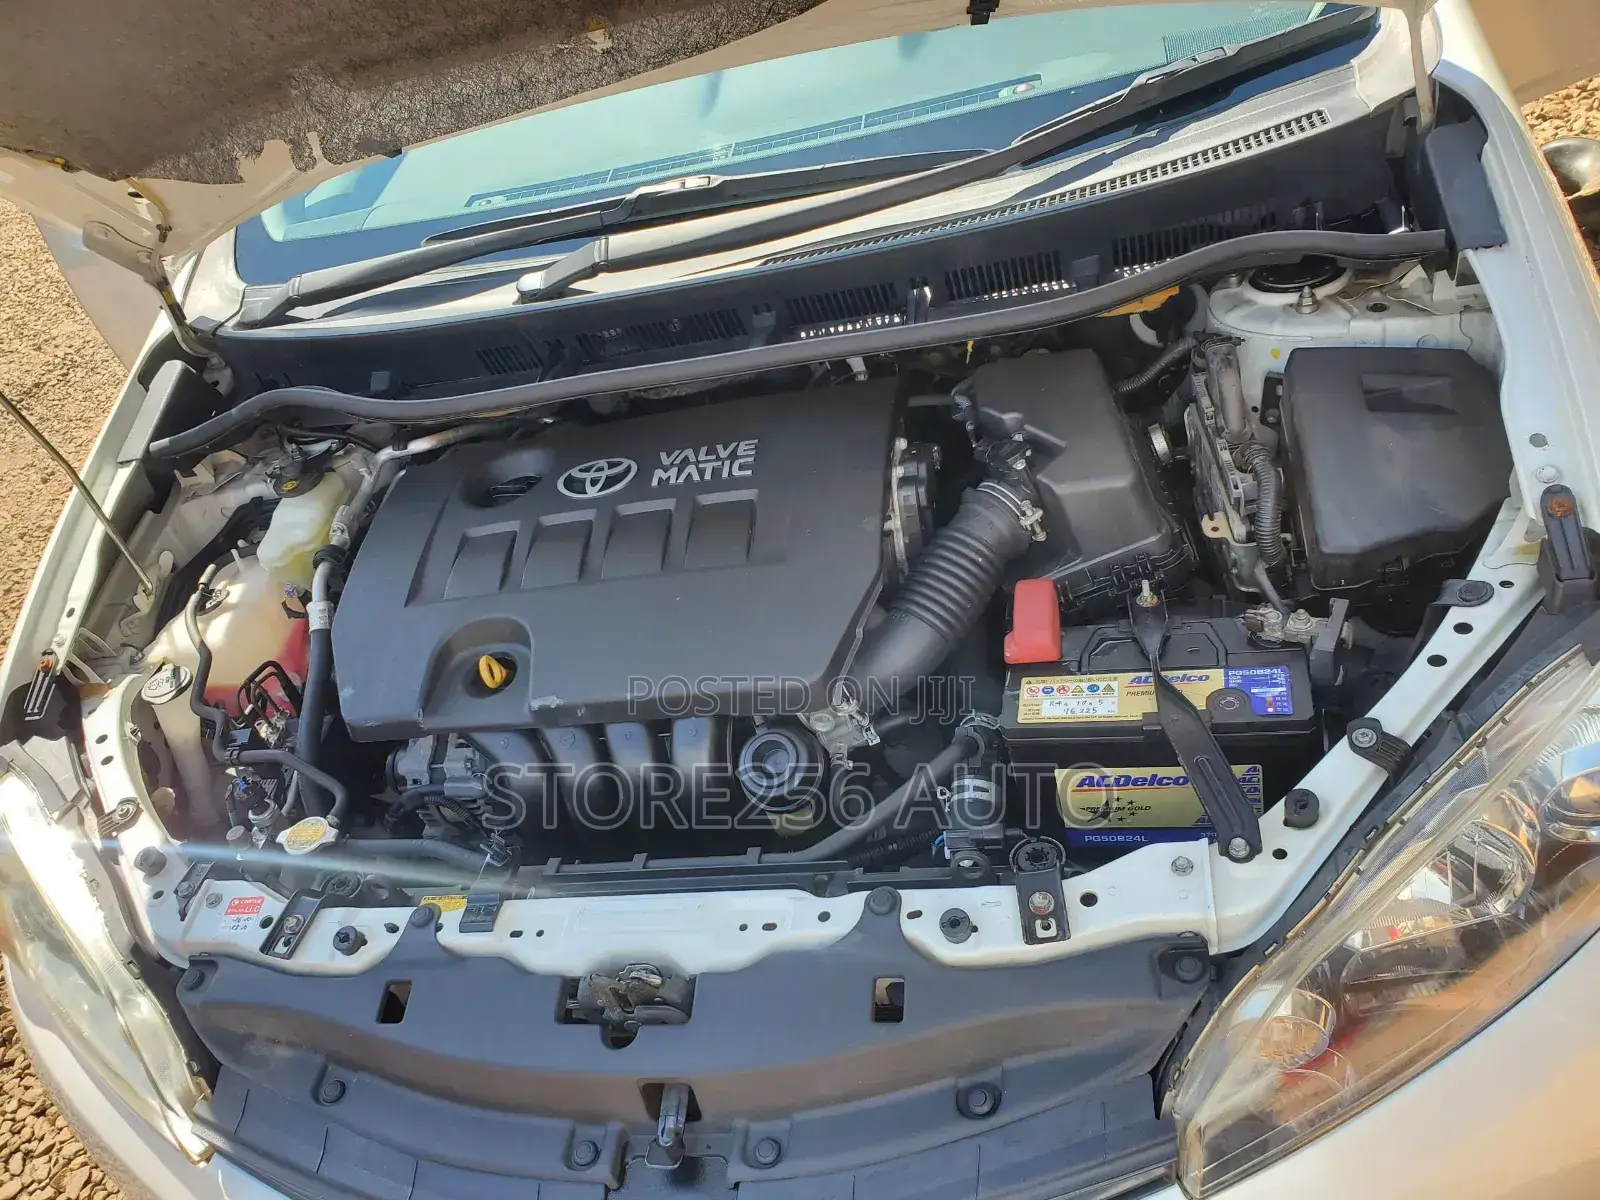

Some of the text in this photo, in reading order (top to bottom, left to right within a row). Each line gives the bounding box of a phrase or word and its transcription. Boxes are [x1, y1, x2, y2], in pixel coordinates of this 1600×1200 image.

[659, 439, 759, 466] VALVE
[651, 456, 755, 487] MATIC
[1075, 774, 1191, 788] ACDelco
[1084, 834, 1149, 842] PG50B24L
